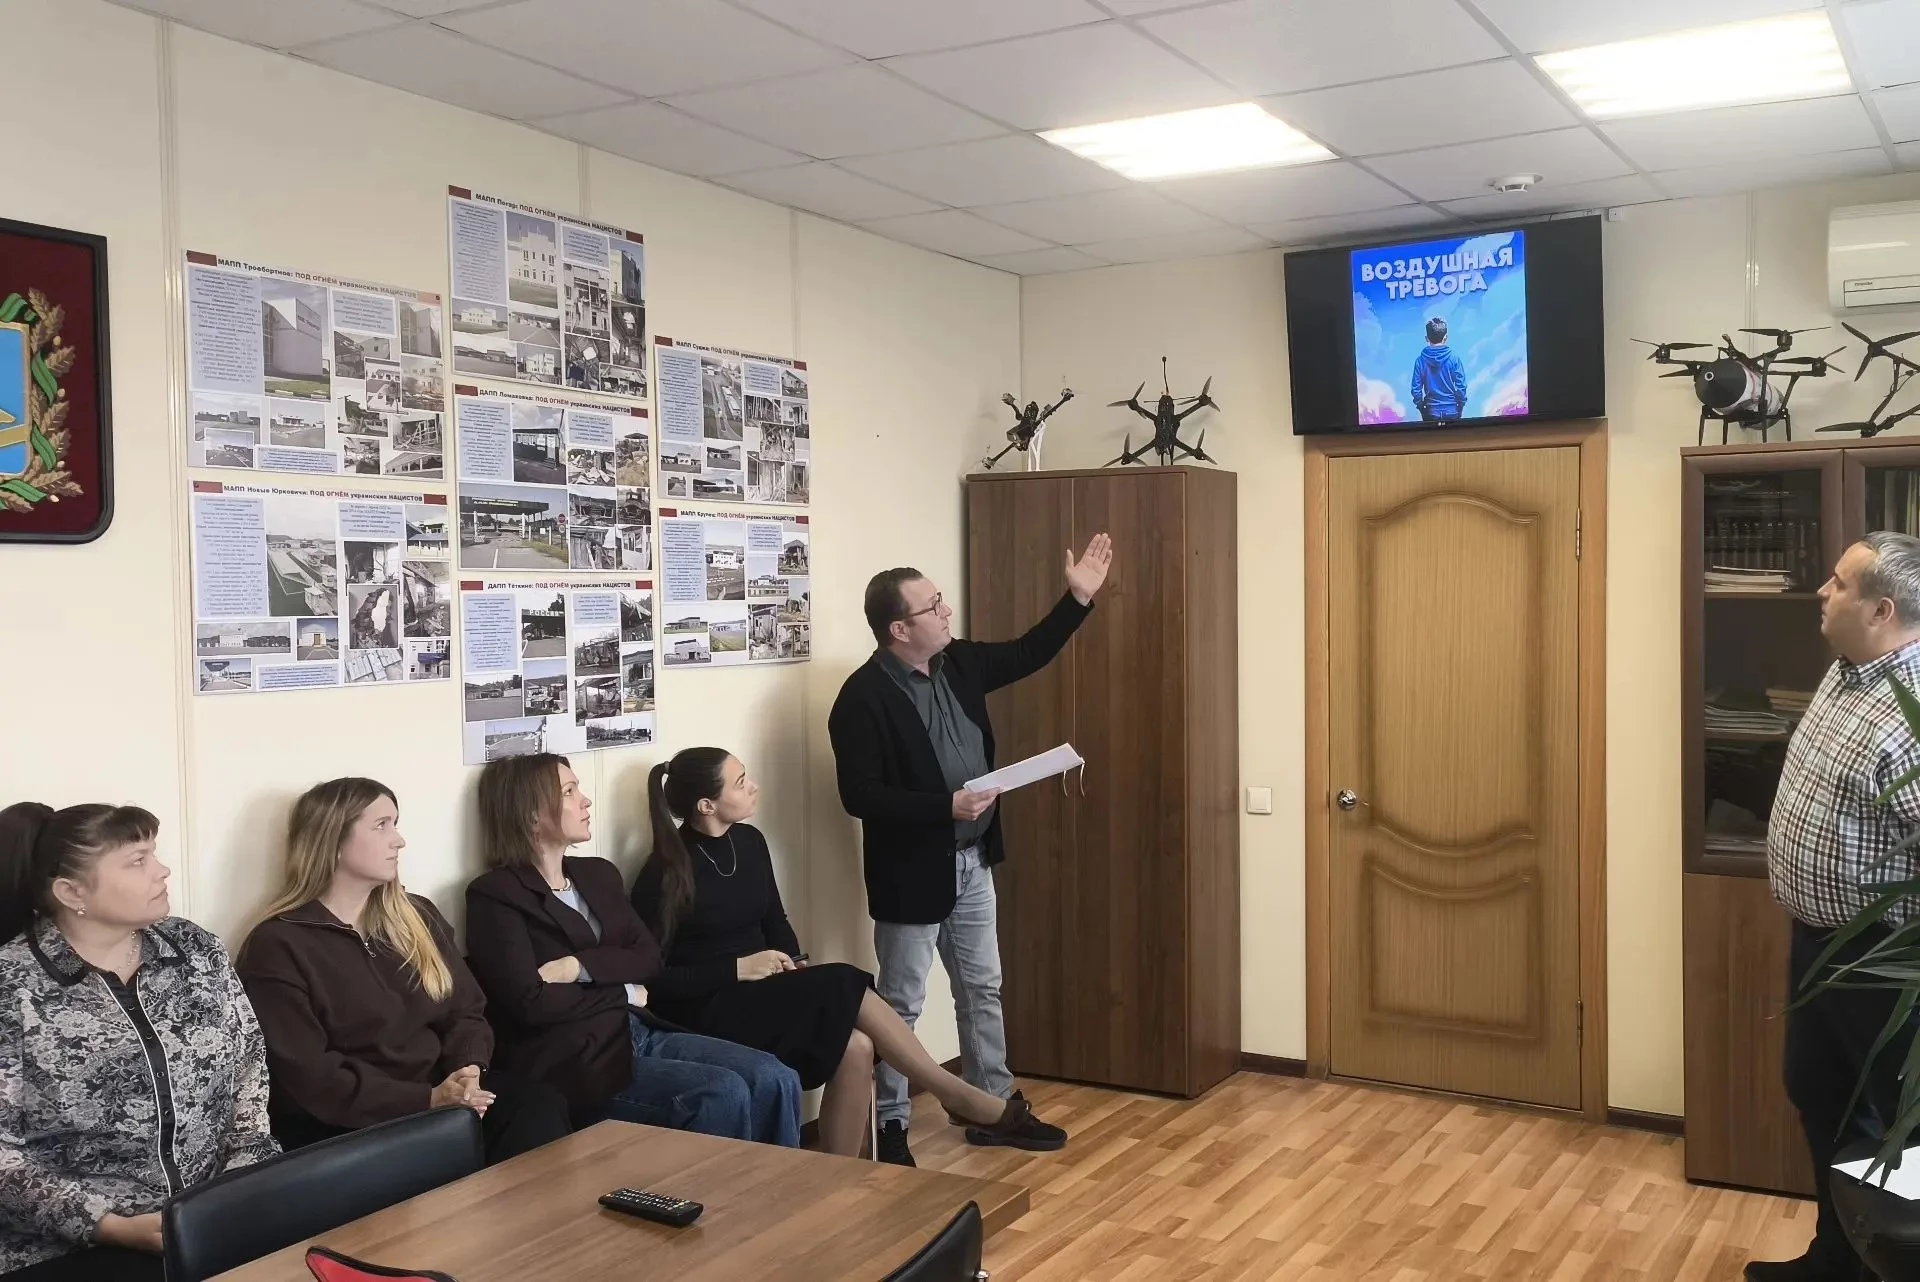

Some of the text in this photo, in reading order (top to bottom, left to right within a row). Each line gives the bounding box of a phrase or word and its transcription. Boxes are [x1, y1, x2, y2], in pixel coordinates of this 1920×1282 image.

[476, 193, 496, 203] МАПП
[519, 204, 534, 213] ПОД
[592, 222, 622, 236] НАЦИСТОВ
[218, 258, 241, 268] МАПП
[243, 262, 294, 277] Троебортное:
[295, 272, 311, 281] ПОД
[380, 287, 417, 298] НАЦИСТОВ
[1361, 247, 1513, 282] ВОЗДУШНАЯ
[1385, 272, 1488, 300] ТРЕВОГА
[711, 346, 722, 354] ПОД
[535, 396, 548, 404] ПОД
[602, 405, 630, 414] НАЦИСТОВ
[310, 489, 325, 497] ПОД
[389, 494, 423, 502] НАЦИСТОВ
